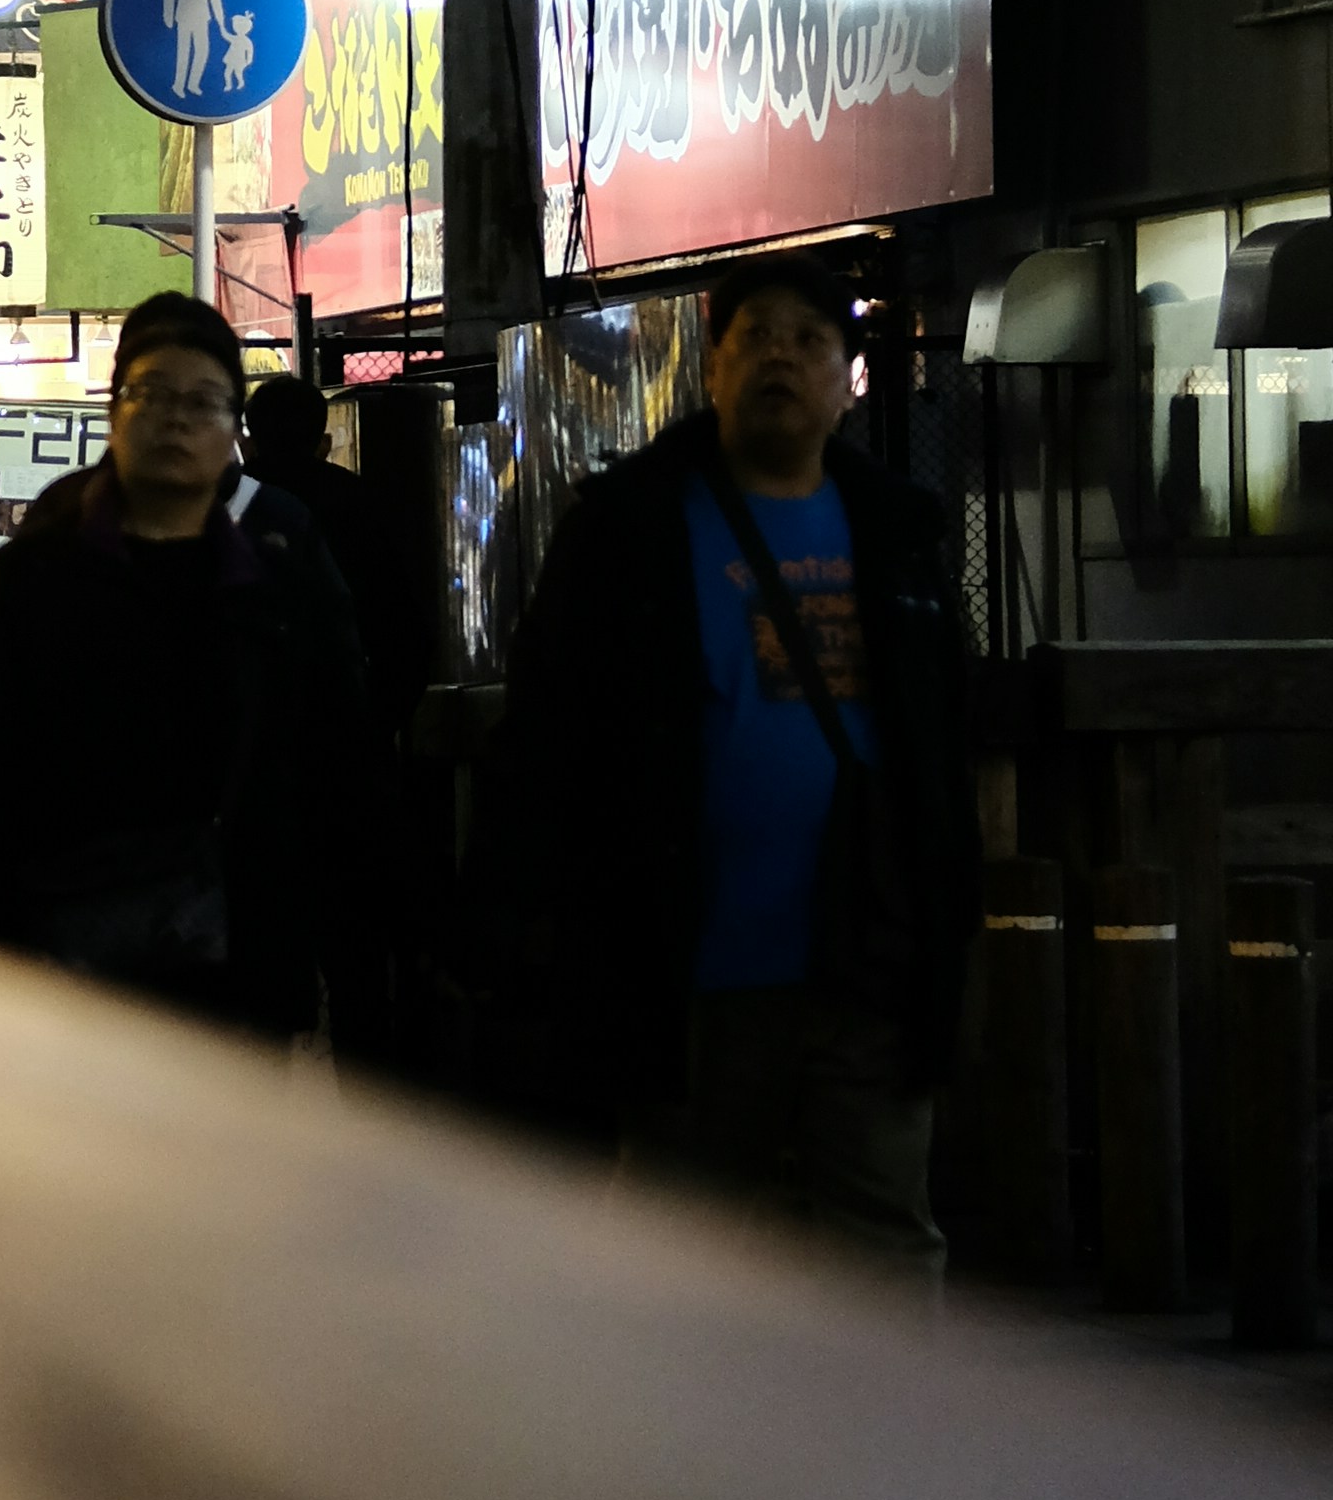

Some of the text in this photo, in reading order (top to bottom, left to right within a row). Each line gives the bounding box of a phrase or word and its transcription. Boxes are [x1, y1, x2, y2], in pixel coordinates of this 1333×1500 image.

[7, 92, 35, 238] 炭火やきとり
[389, 159, 430, 195] TENOKU
